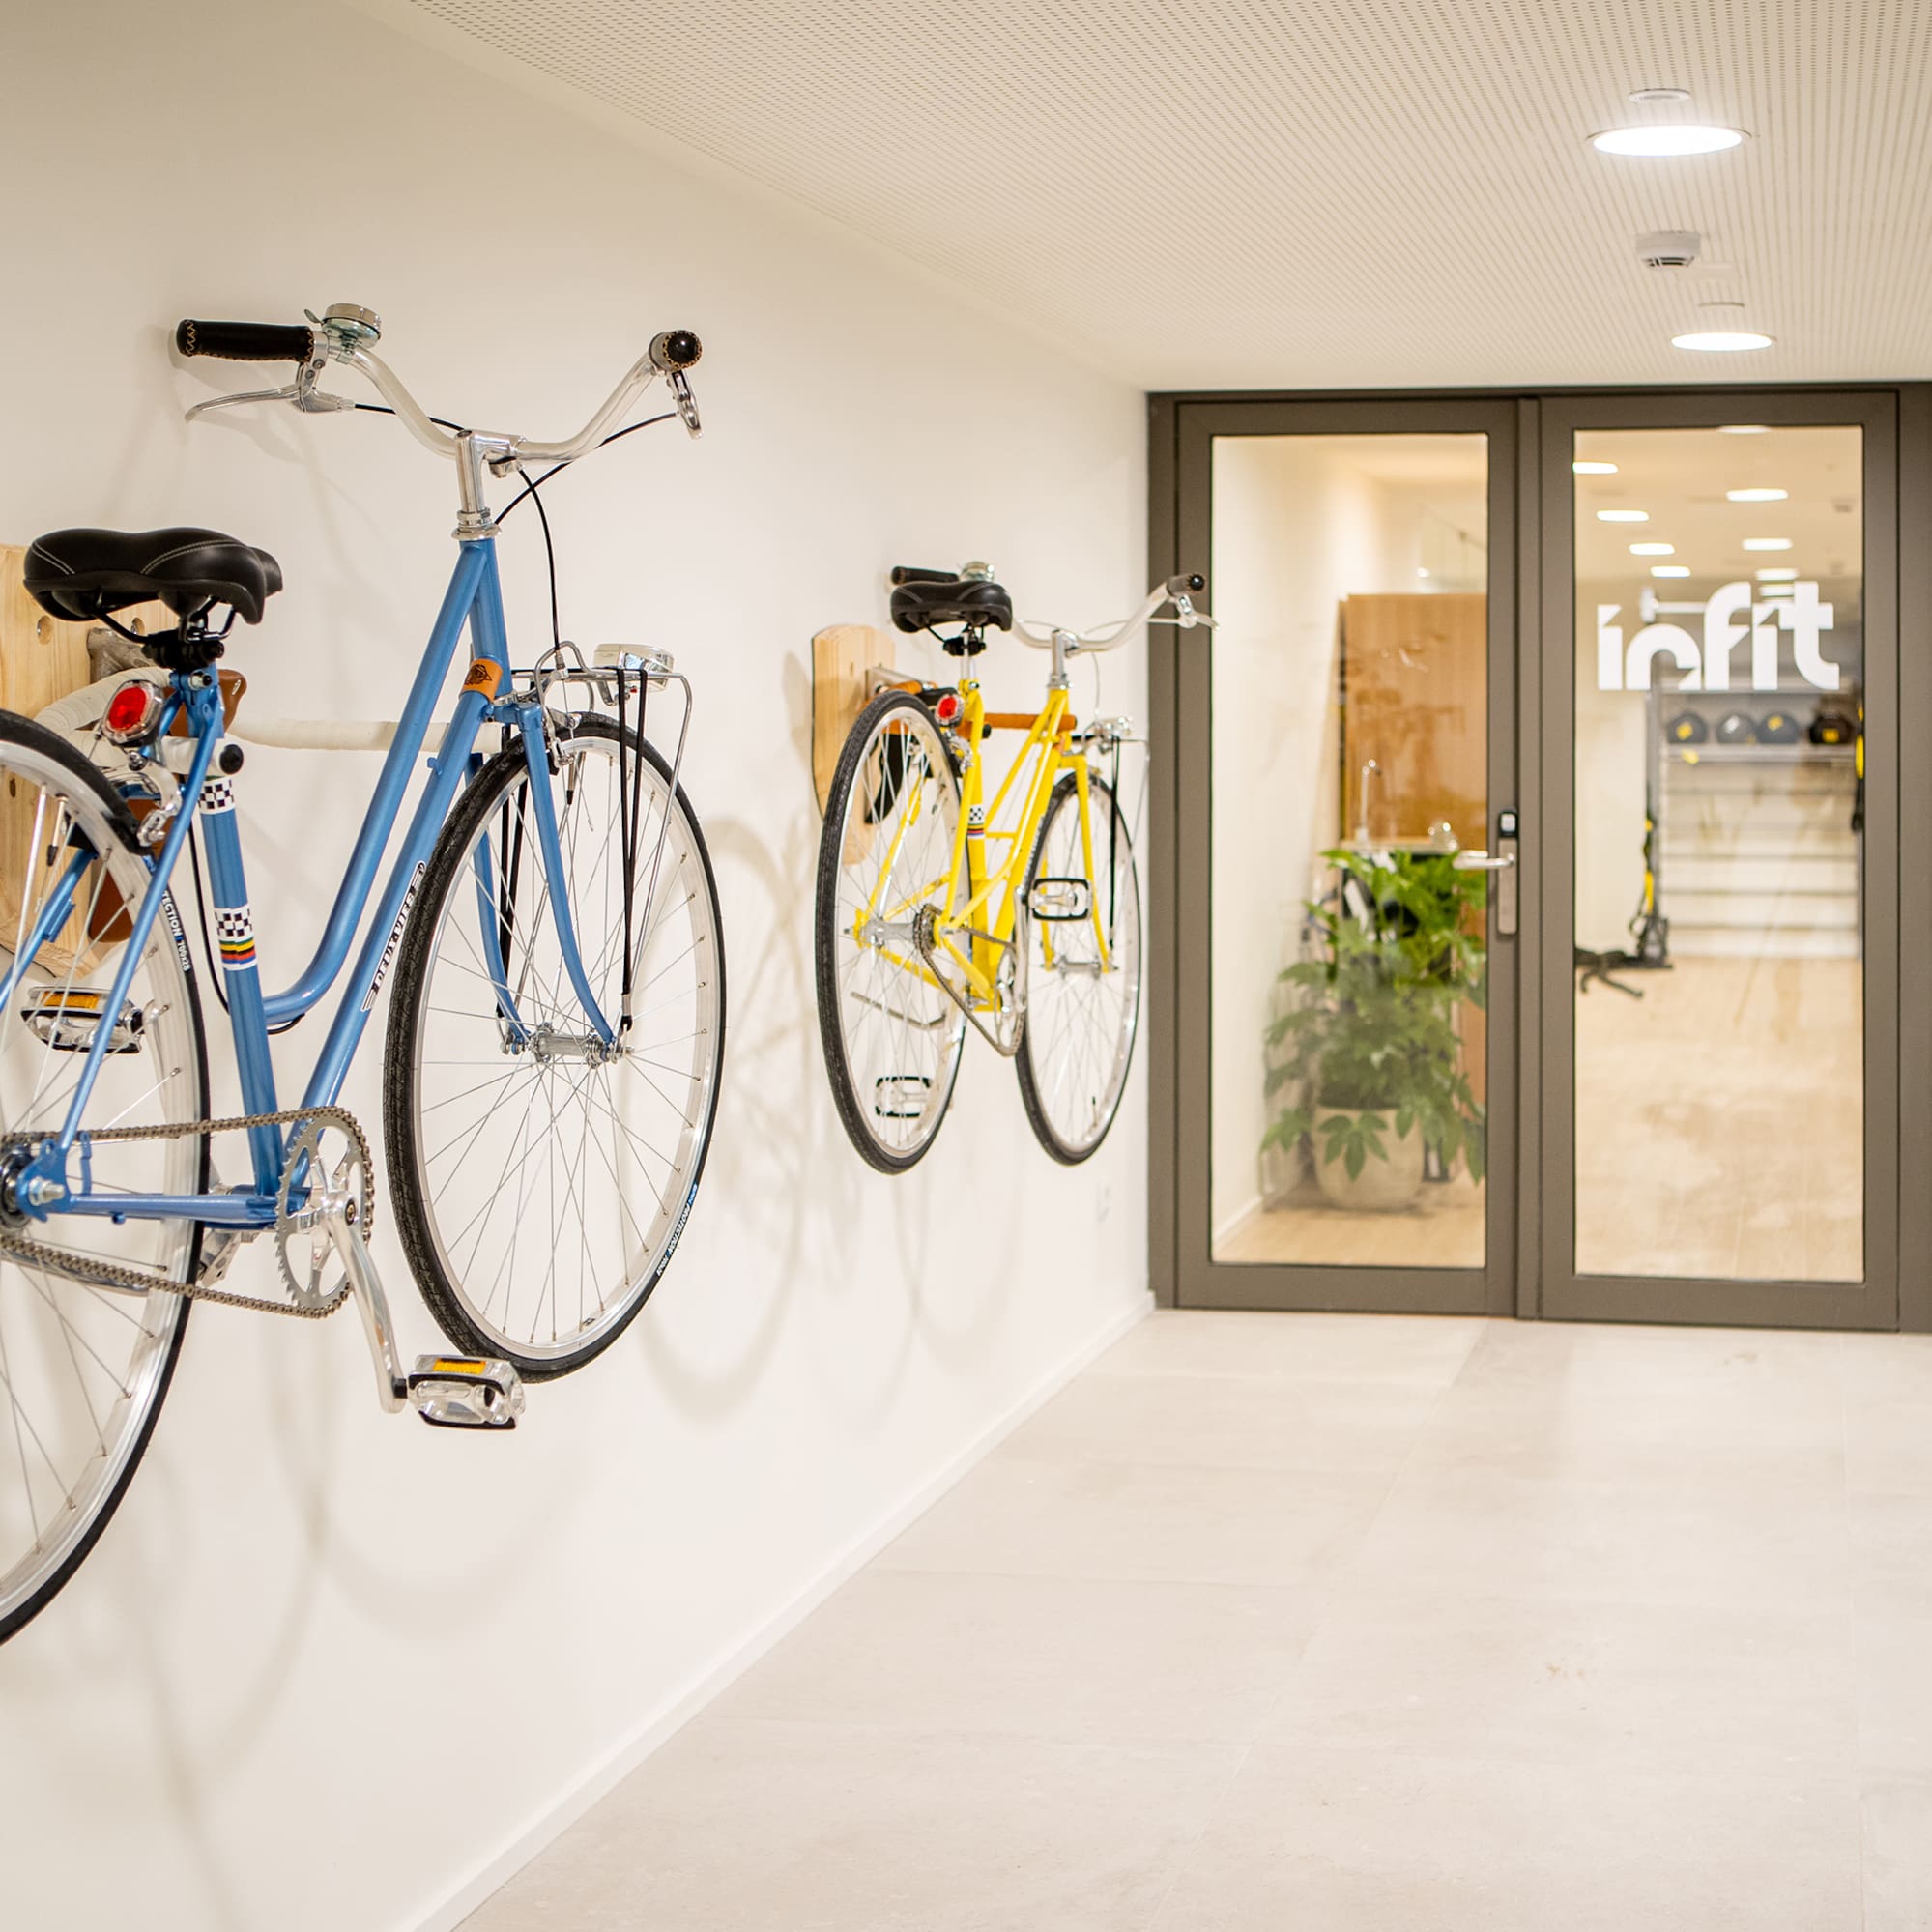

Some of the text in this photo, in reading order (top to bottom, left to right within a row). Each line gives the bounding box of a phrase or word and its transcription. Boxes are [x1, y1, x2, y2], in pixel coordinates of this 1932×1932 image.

[1598, 581, 1839, 690] infit
[162, 890, 191, 972] TECTION 700x28
